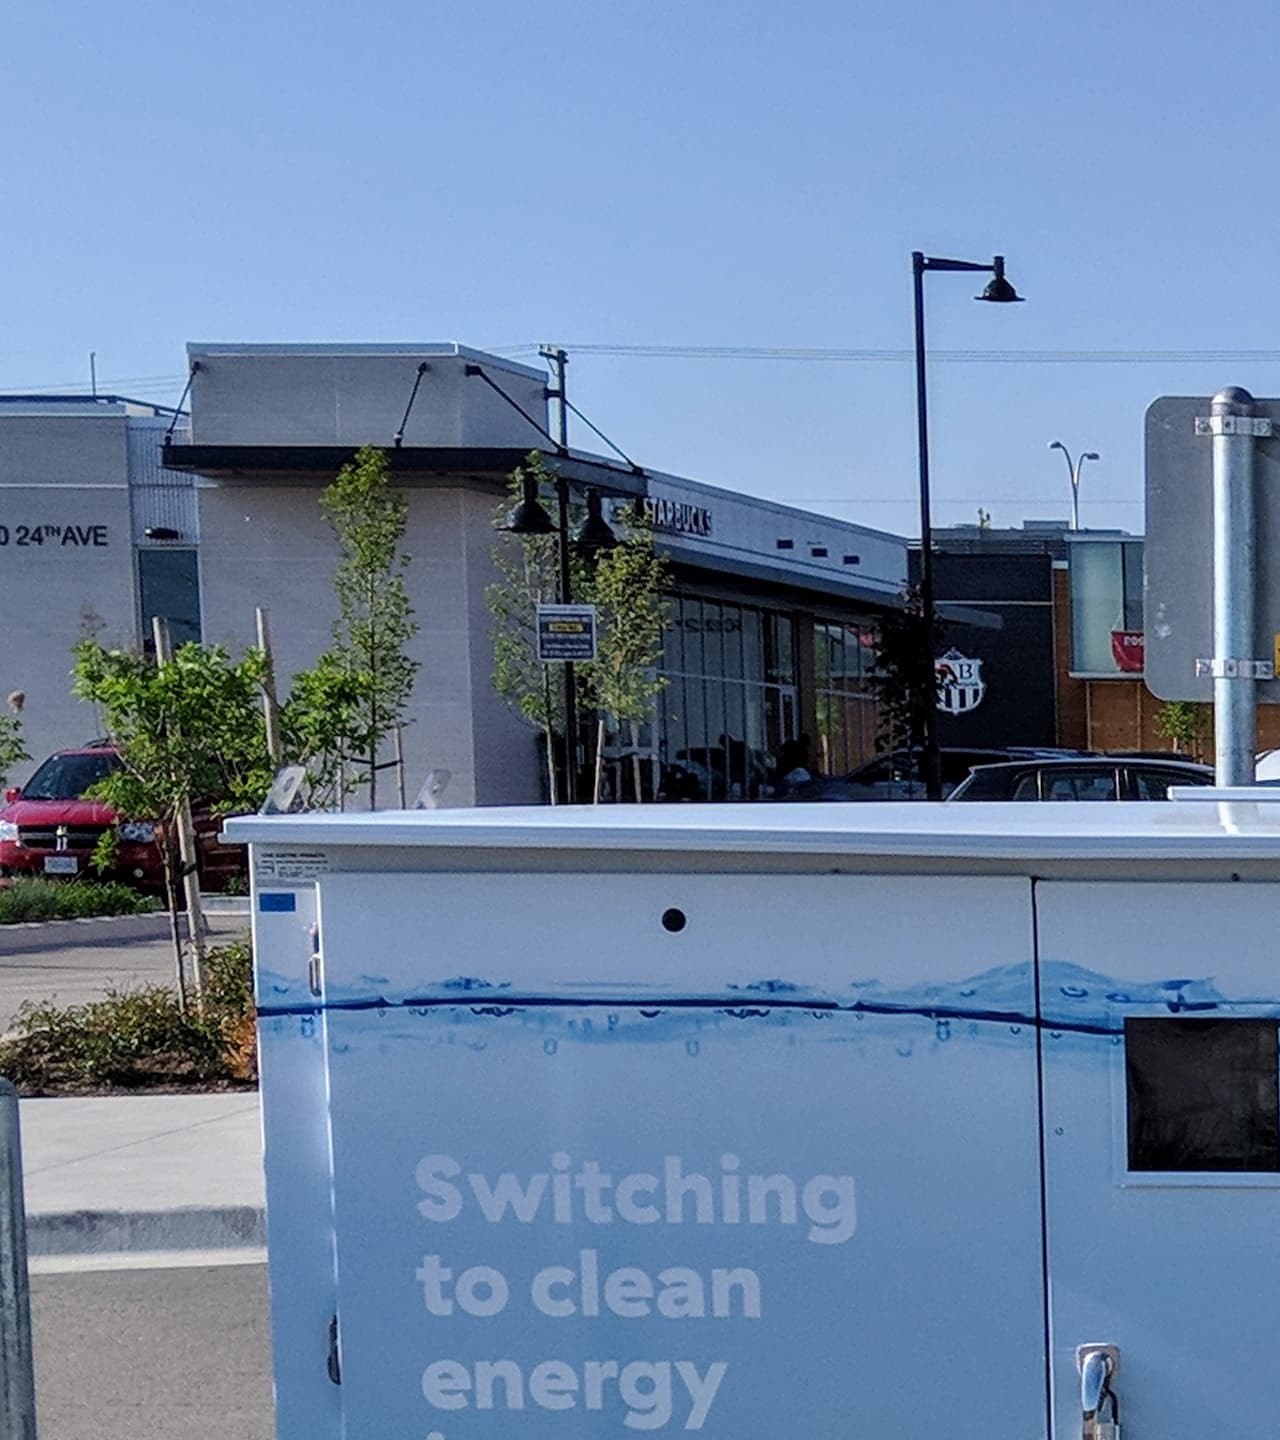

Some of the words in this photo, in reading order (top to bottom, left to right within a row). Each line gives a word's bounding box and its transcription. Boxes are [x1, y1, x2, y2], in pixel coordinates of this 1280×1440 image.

[414, 1151, 857, 1245] Switching
[415, 1253, 509, 1317] to
[531, 1249, 761, 1319] clean
[421, 1359, 729, 1430] energy
